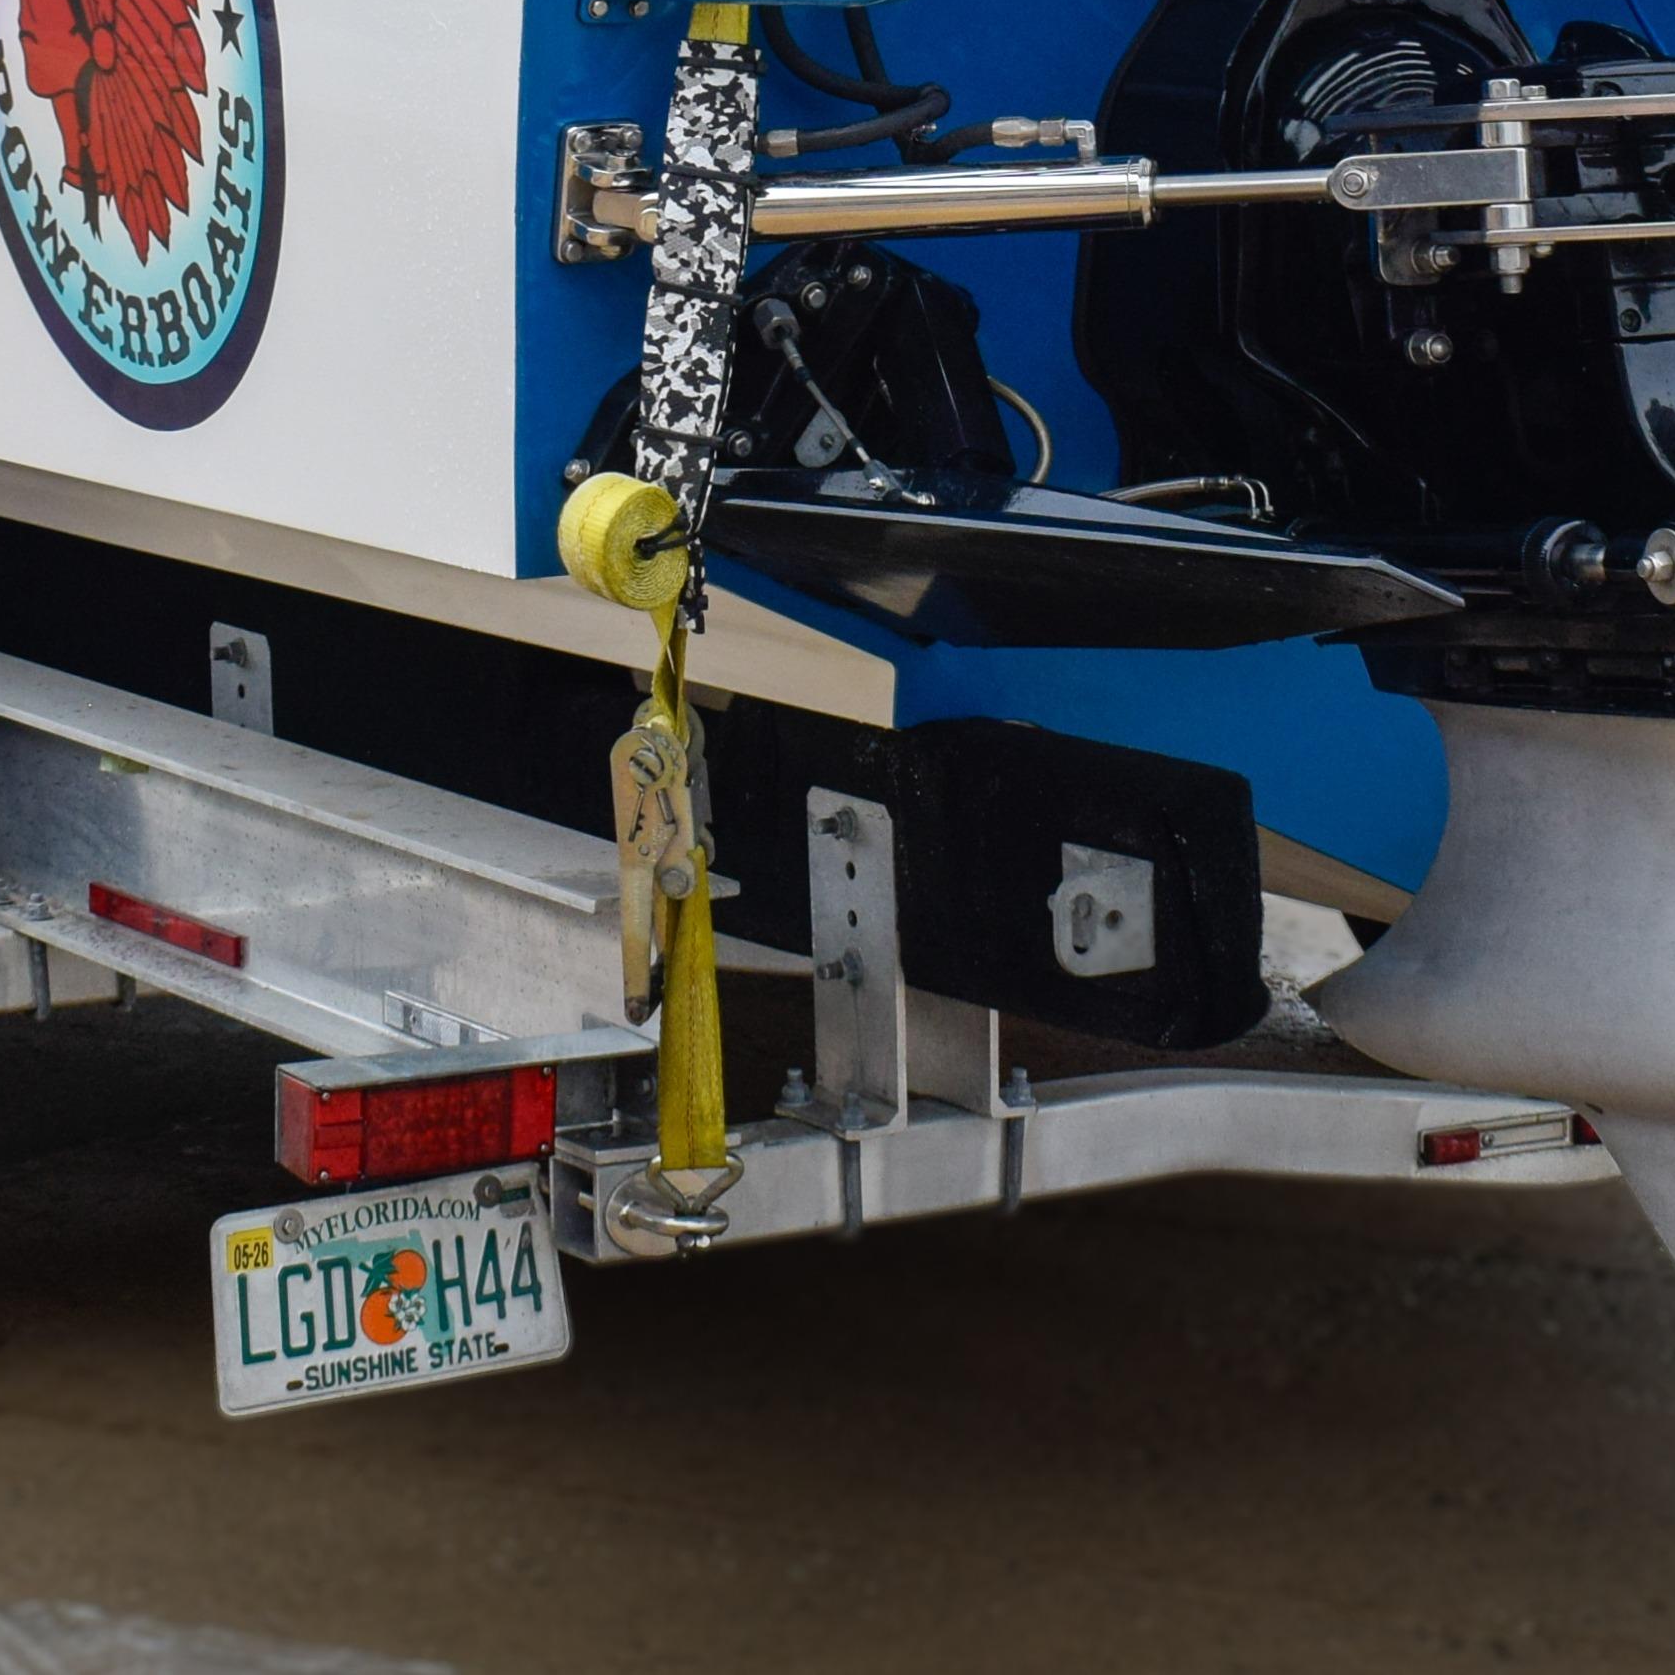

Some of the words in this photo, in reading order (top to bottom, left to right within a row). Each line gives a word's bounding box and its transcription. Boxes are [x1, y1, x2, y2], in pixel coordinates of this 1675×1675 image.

[233, 1240, 270, 1269] 05-26
[236, 1257, 357, 1366] LGD
[431, 1222, 543, 1332] H44
[304, 1346, 419, 1392] SUNSHINE
[429, 1331, 497, 1370] STATE
